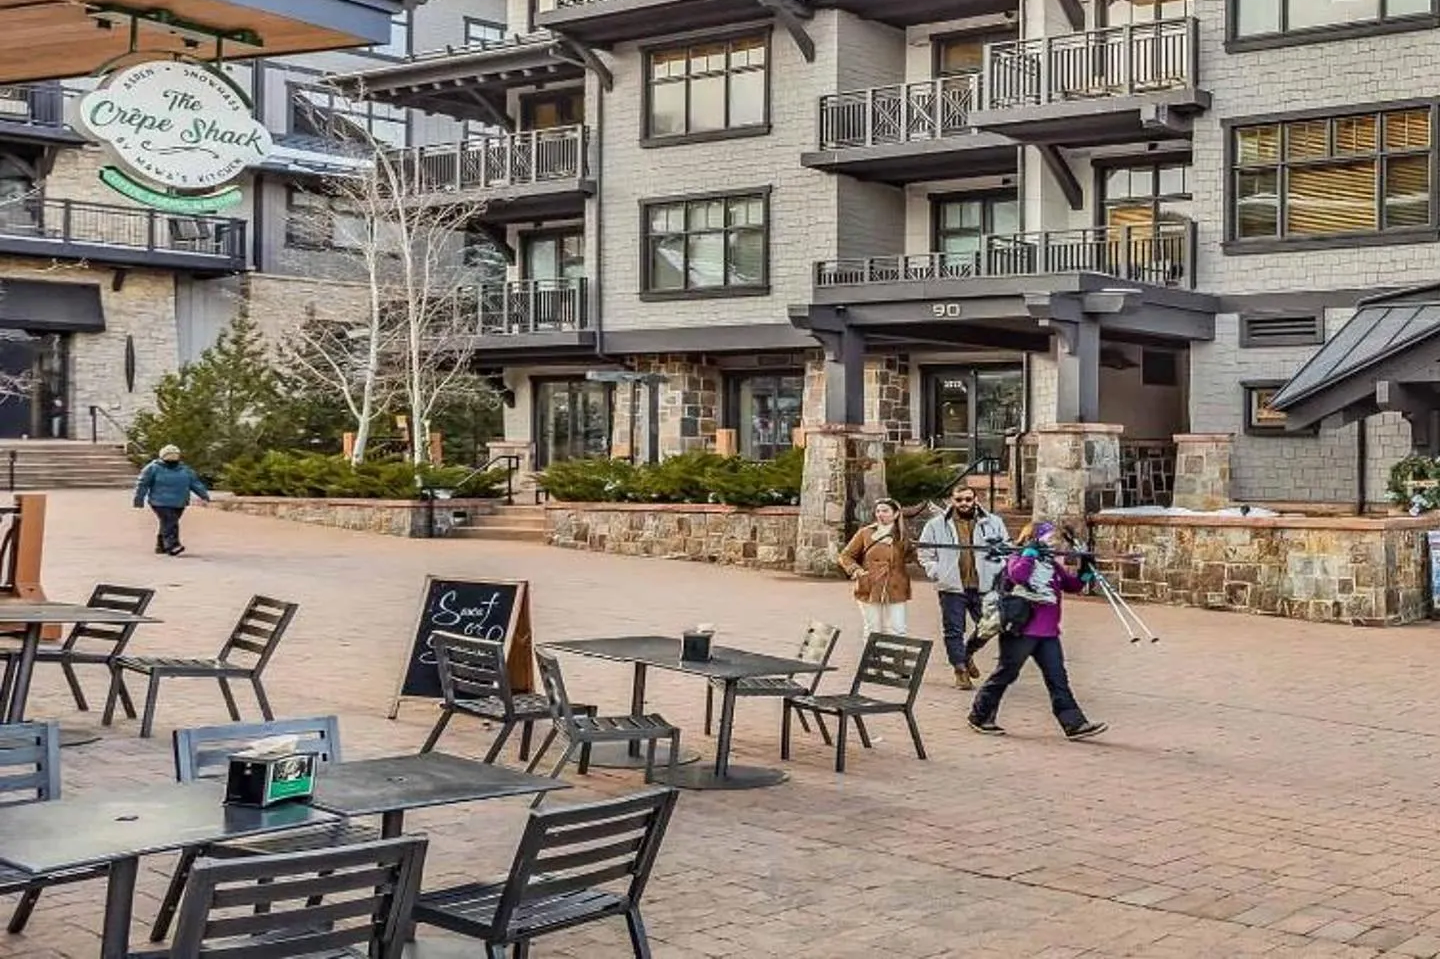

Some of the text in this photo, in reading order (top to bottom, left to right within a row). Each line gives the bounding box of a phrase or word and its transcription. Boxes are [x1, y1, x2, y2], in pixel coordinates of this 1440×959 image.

[123, 68, 155, 90] ASPEN
[162, 88, 203, 112] The
[89, 99, 265, 157] Crêpe Shack
[932, 303, 961, 317] 90
